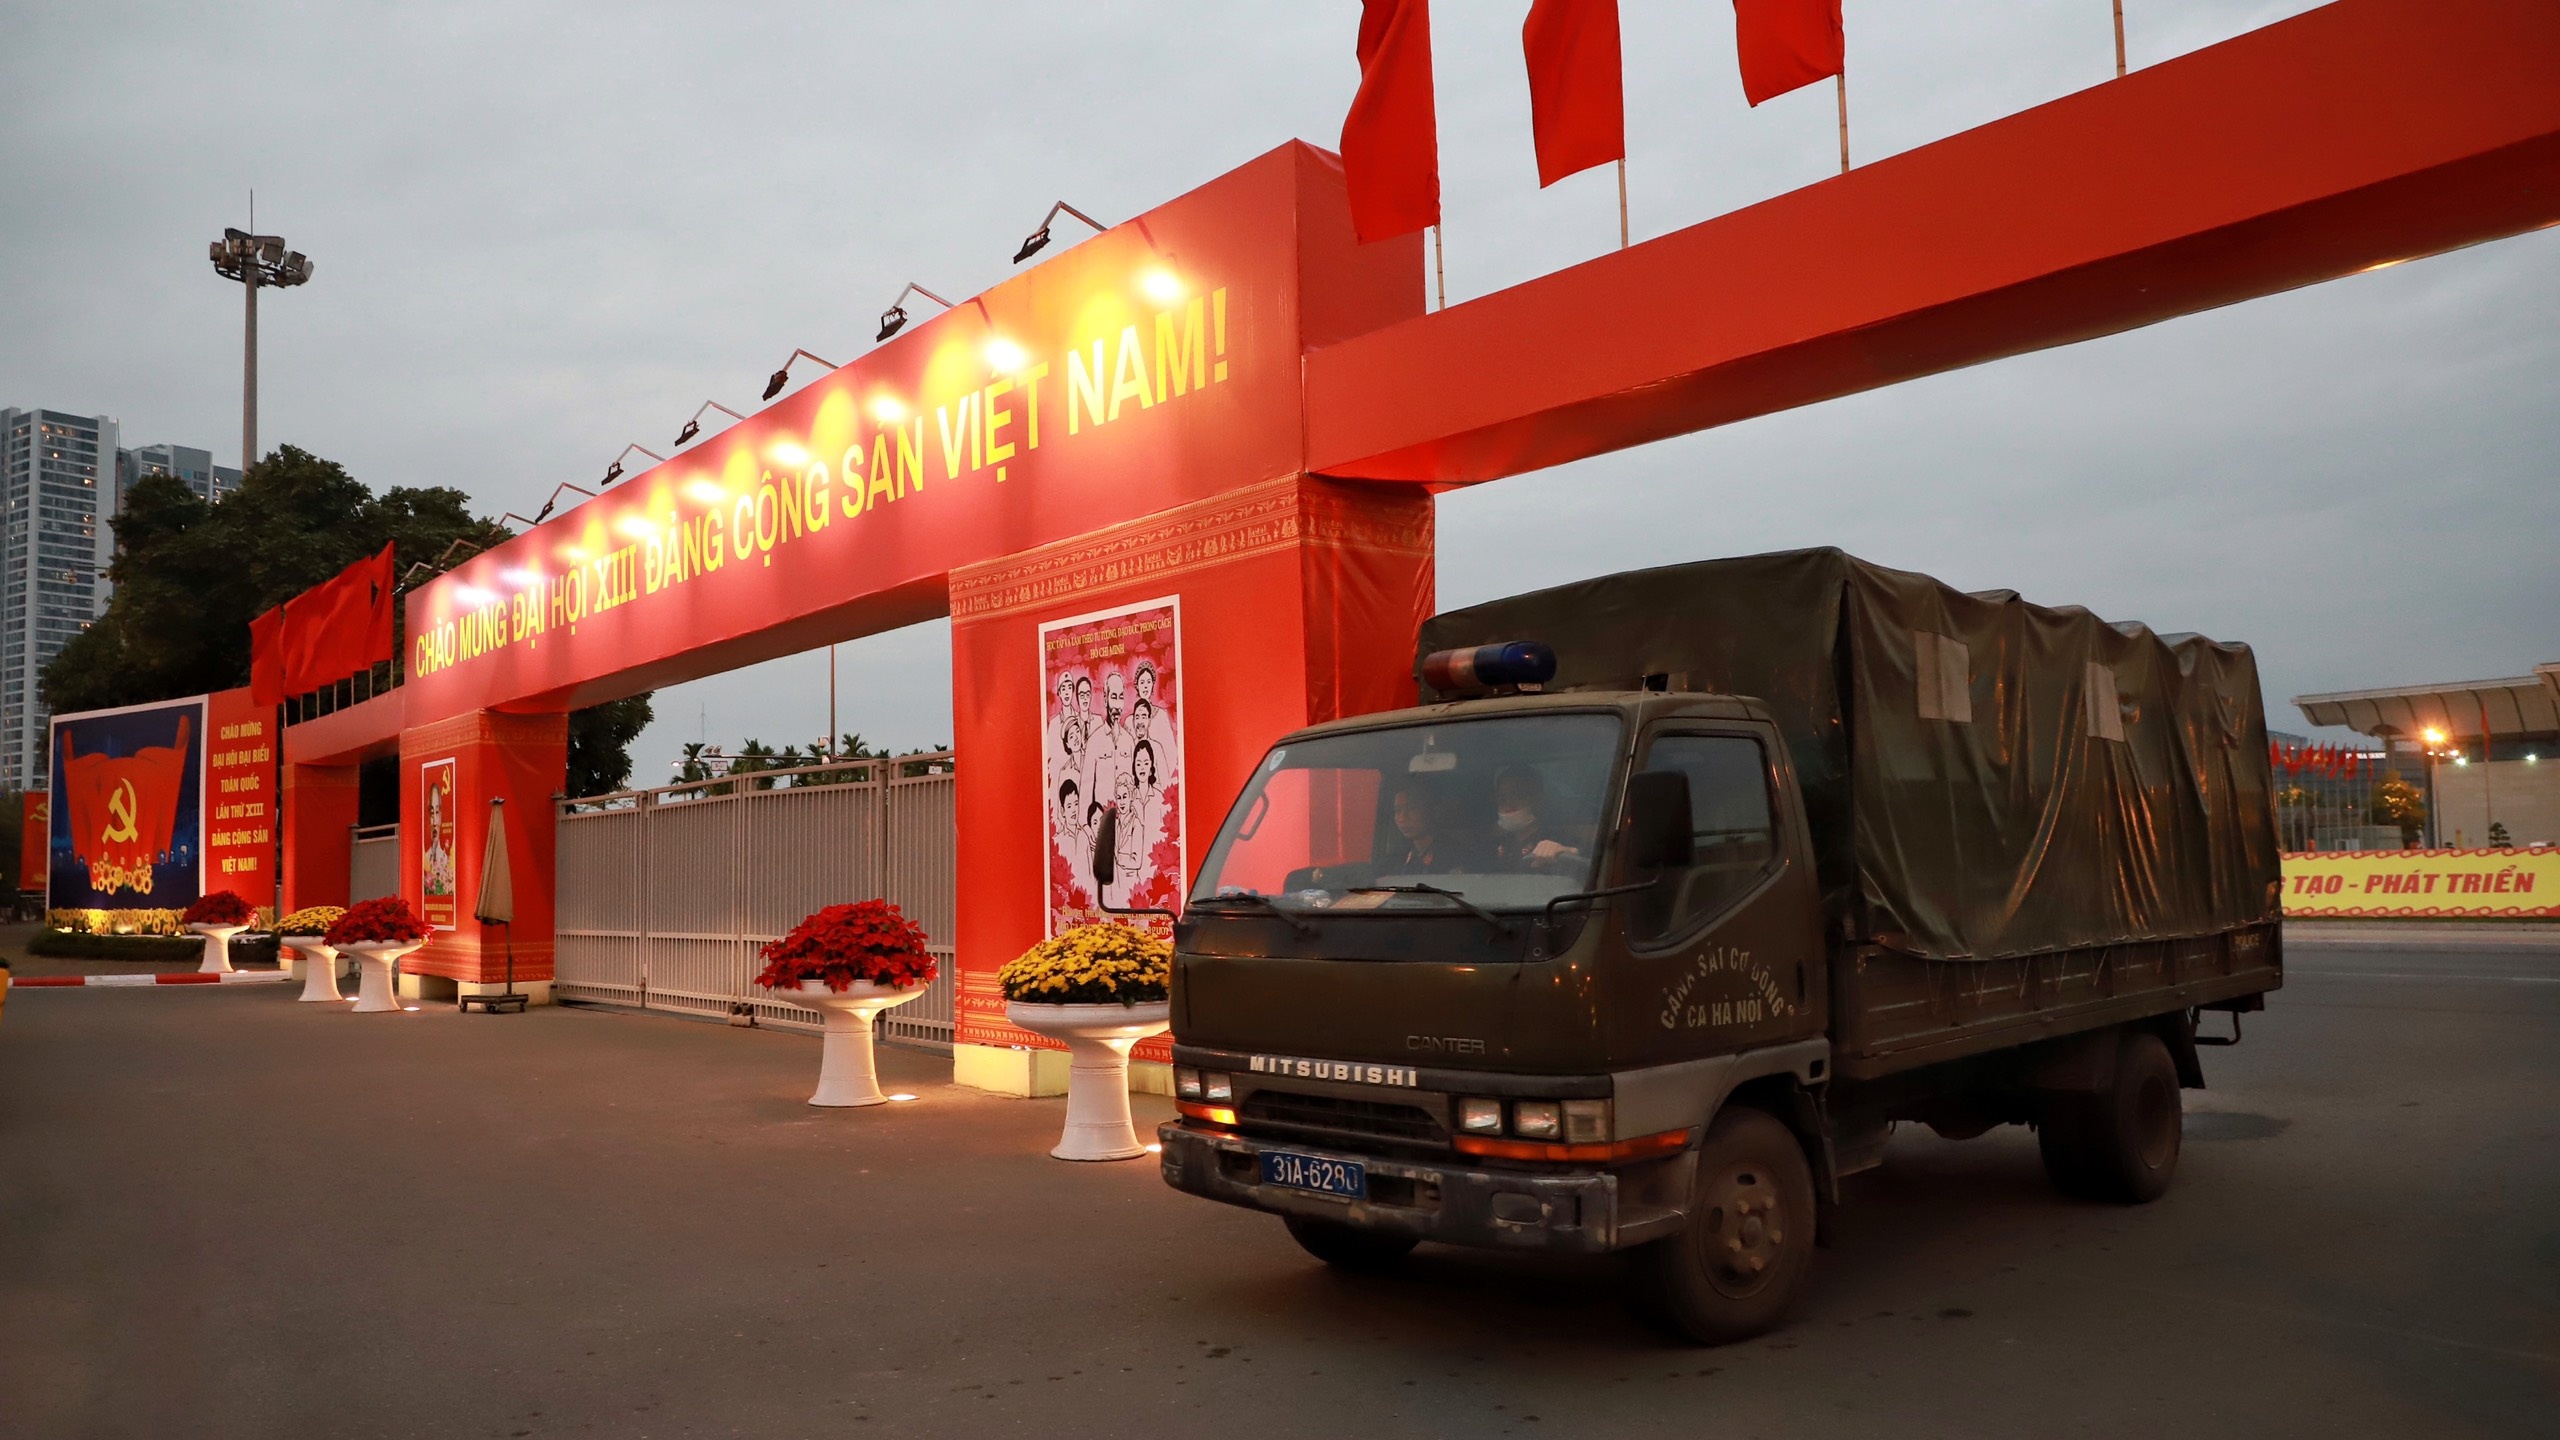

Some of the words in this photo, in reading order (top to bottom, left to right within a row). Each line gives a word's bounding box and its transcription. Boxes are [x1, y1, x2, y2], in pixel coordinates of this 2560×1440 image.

[415, 616, 456, 678] CHÀO
[512, 582, 545, 649] ĐẠI
[551, 560, 588, 635] HỘI
[594, 544, 637, 613] XIII
[645, 508, 724, 594] ĐẢNG
[733, 462, 830, 567] CỘNG
[1066, 287, 1229, 436] NAM!
[245, 803, 264, 817] XIII
[222, 856, 236, 875] VIỆT
[238, 857, 257, 872] NAM!
[2293, 874, 2344, 898] TẠO
[2364, 869, 2440, 894] PHÁT
[2446, 864, 2536, 893] TRIỂN
[1687, 1005, 1706, 1028] CA
[1712, 994, 1732, 1026] HÀ
[1406, 1035, 1486, 1055] CANTER
[1250, 1055, 1417, 1087] MITSUBISHI
